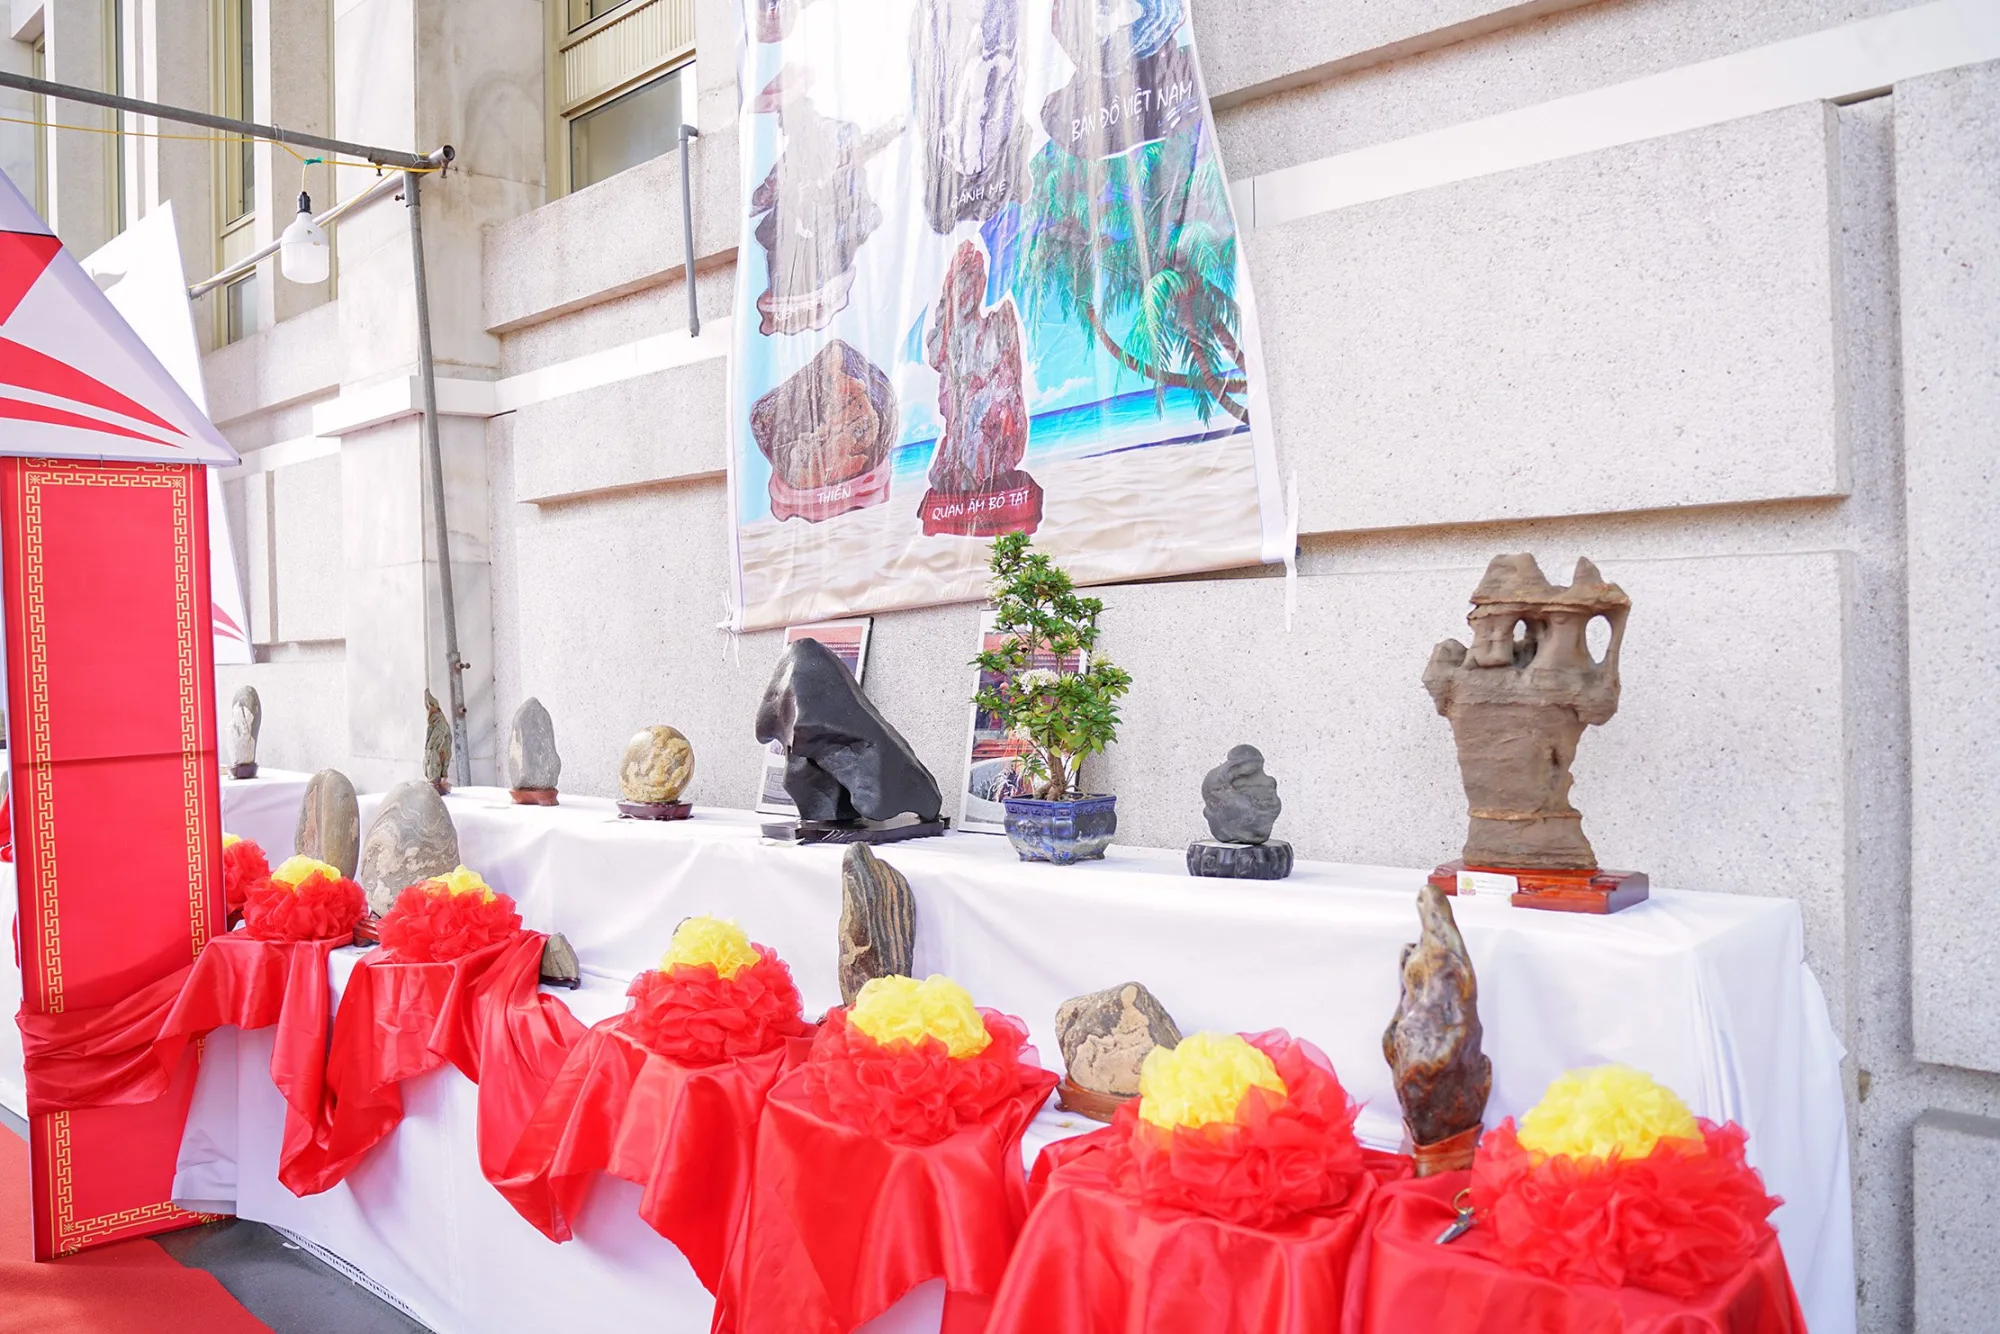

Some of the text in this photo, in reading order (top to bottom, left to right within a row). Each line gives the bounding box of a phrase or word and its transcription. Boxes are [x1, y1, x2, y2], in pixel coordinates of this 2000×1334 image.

[1123, 88, 1152, 121] VIỆT
[1157, 80, 1193, 111] NAM
[931, 503, 964, 521] QUAN
[967, 498, 985, 514] ÂM
